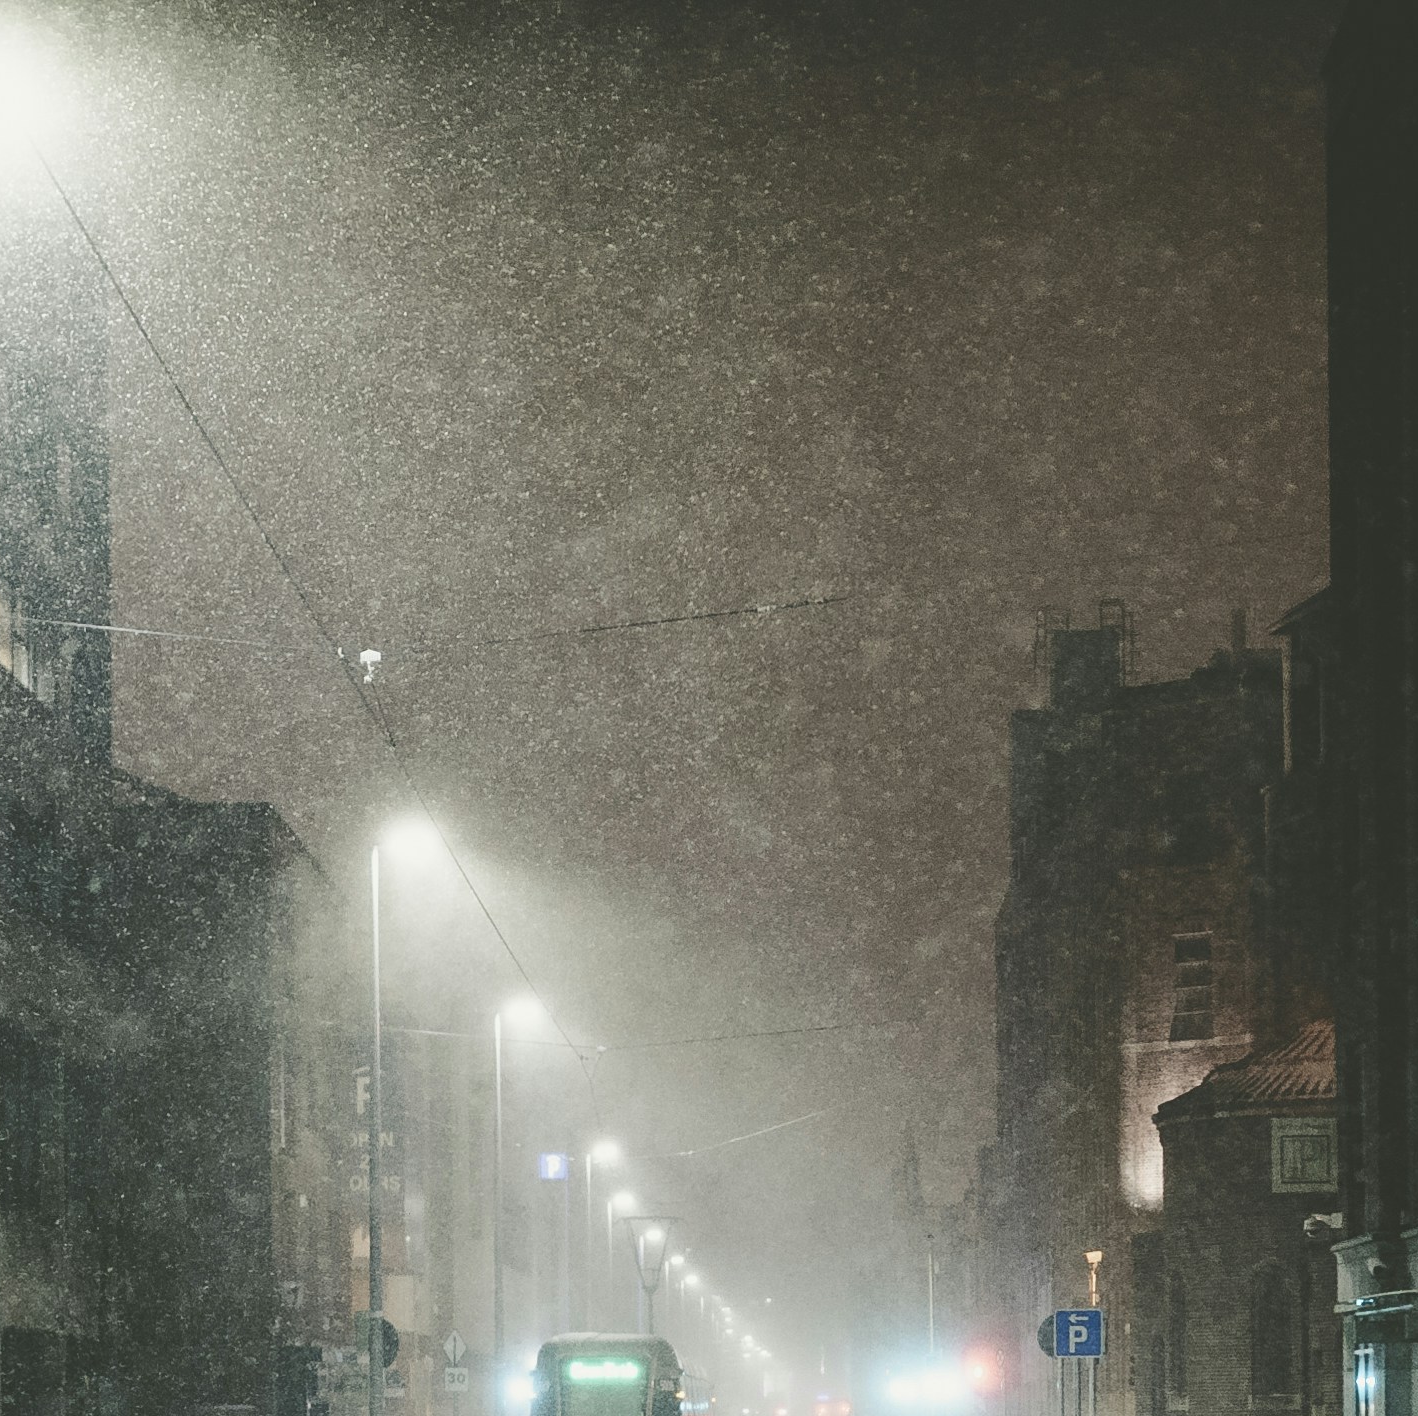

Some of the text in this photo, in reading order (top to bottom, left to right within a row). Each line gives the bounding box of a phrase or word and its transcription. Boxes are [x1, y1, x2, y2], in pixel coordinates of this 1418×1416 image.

[546, 1154, 561, 1179] P
[1069, 1325, 1088, 1353] P
[447, 1371, 466, 1385] 30
